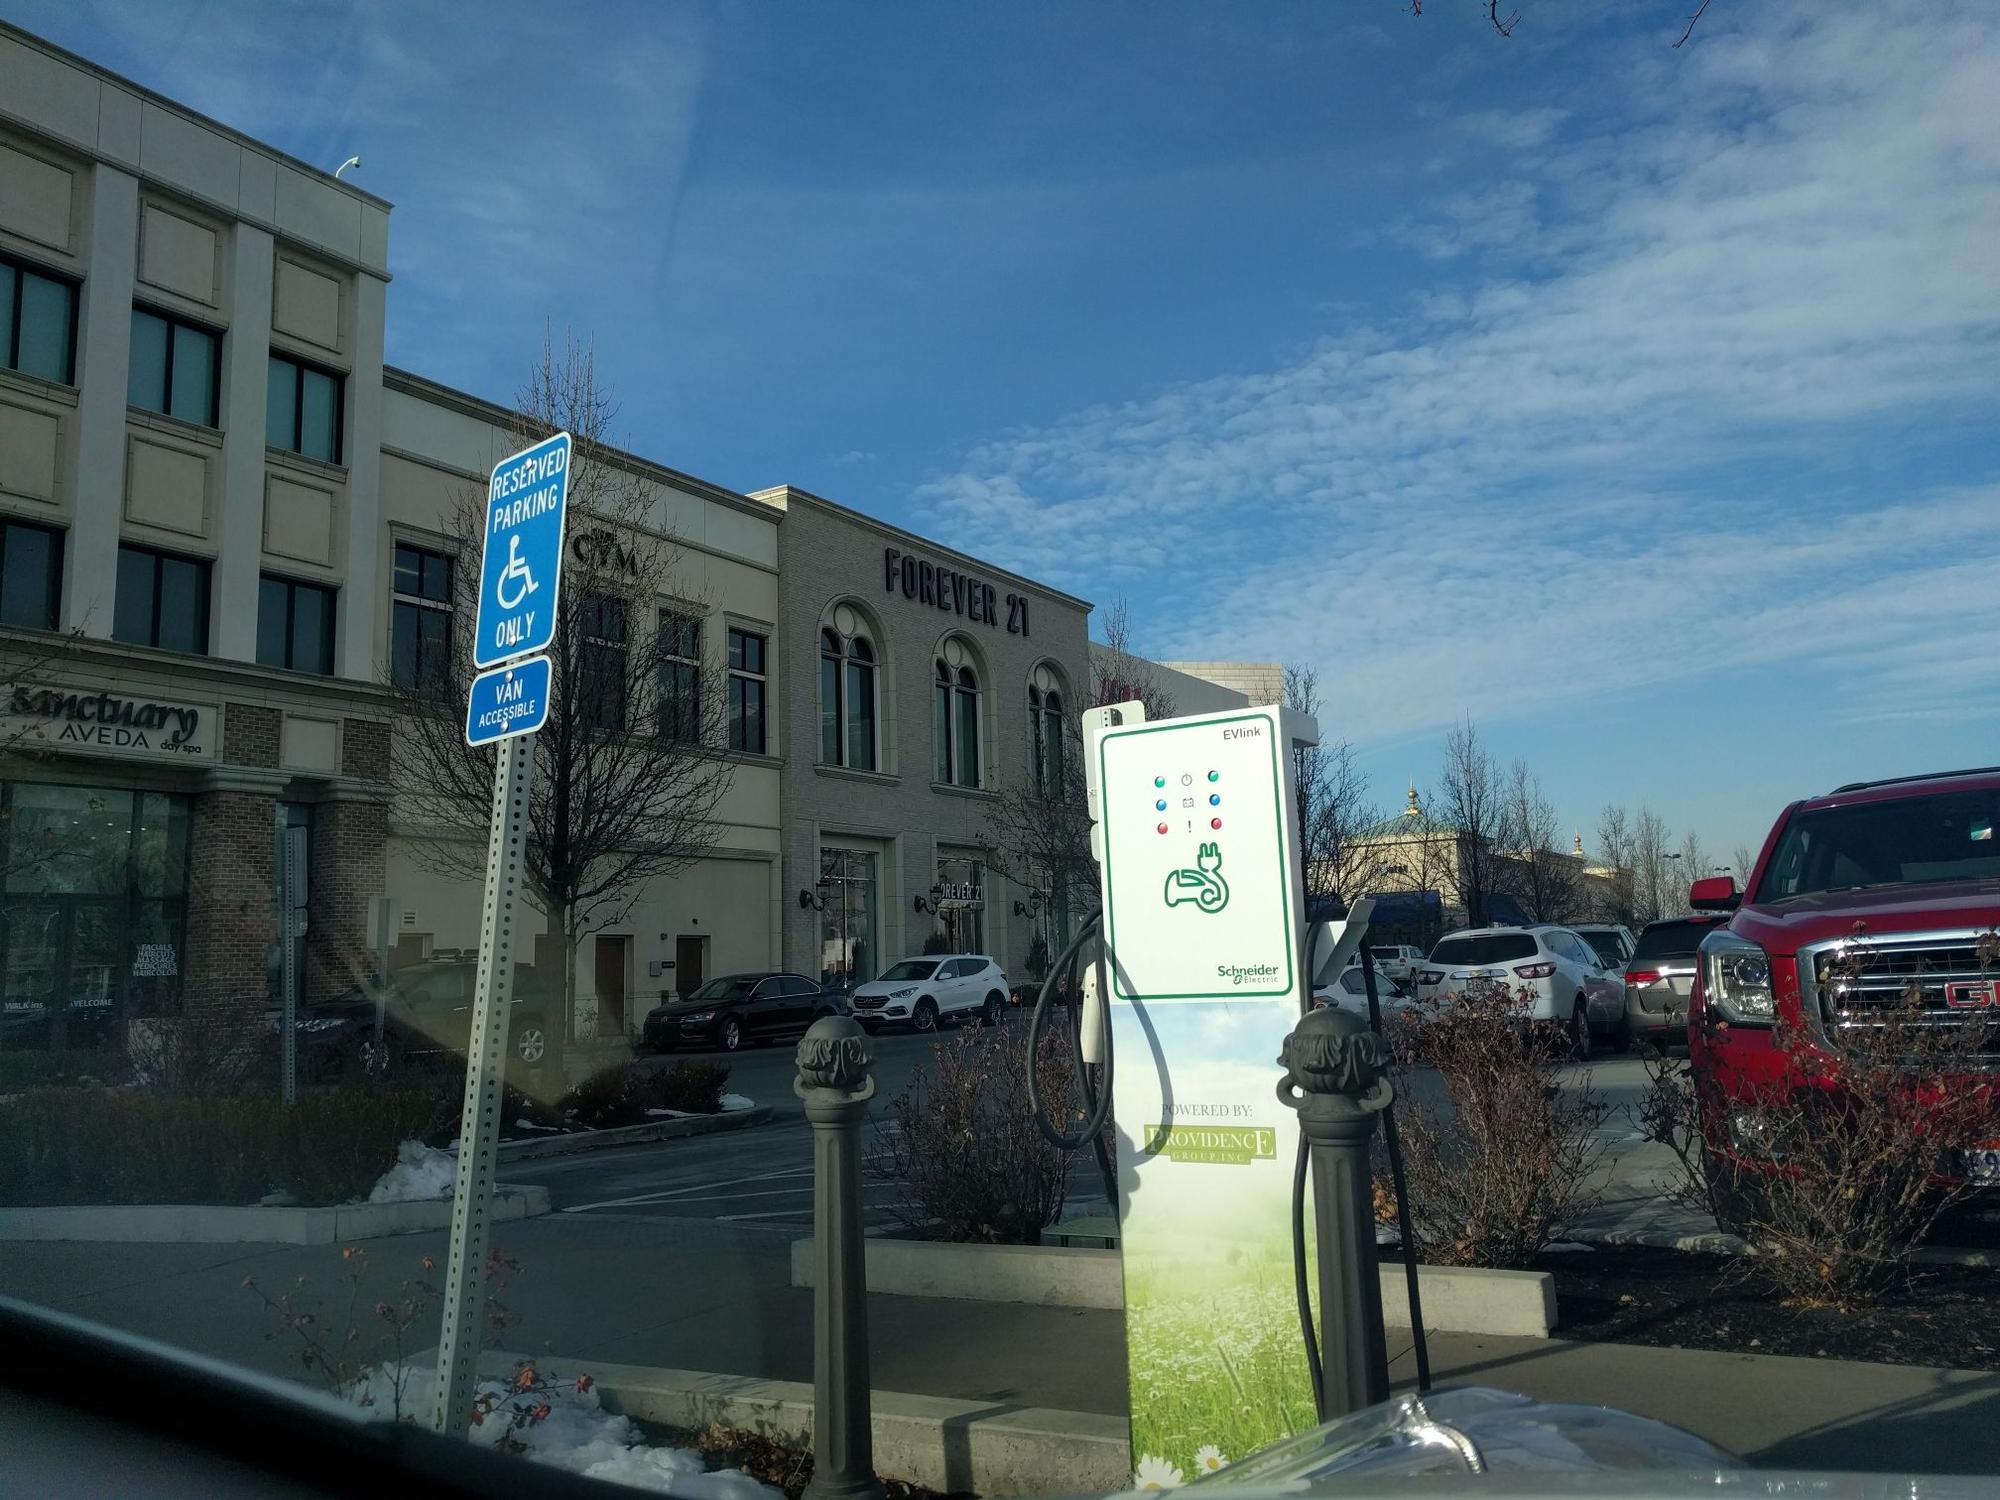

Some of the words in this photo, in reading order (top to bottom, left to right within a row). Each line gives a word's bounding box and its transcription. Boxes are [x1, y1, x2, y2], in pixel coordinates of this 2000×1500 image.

[492, 447, 566, 501] RESERVED
[493, 484, 558, 533] PARKING
[885, 548, 998, 626] FOREVER
[1006, 593, 1030, 637] 21
[496, 611, 536, 649] ONLY
[496, 679, 523, 702] VAN
[10, 686, 199, 744] sanctuary
[478, 700, 535, 728] ACCESSIBLE
[59, 723, 149, 749] AVEDA
[160, 741, 180, 754] day
[182, 743, 202, 754] spa
[1223, 726, 1261, 740] EVlink
[937, 883, 972, 900] OREVER
[1217, 965, 1279, 978] Schneider
[1244, 975, 1279, 984] Electric
[70, 998, 113, 1008] WELCOME
[1162, 1103, 1229, 1117] POWERED
[1233, 1105, 1253, 1117] BY:
[1148, 1128, 1274, 1156] PROVIDENCE
